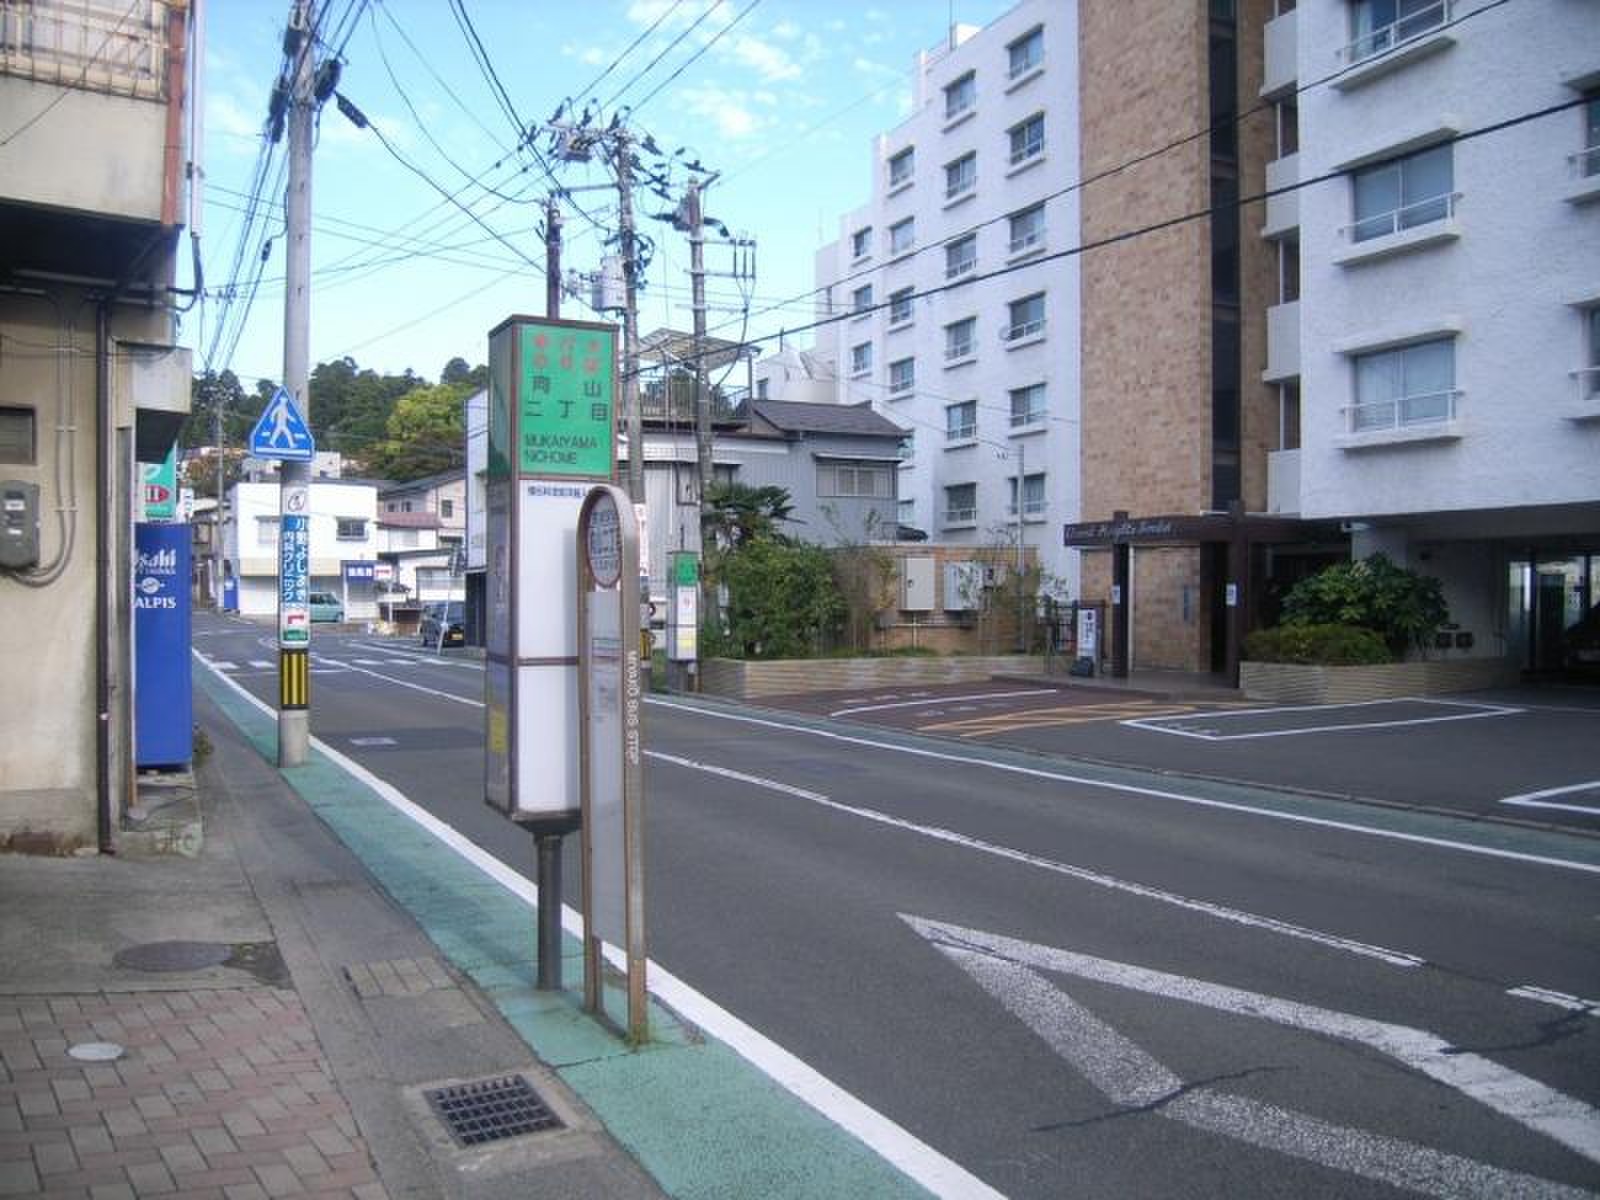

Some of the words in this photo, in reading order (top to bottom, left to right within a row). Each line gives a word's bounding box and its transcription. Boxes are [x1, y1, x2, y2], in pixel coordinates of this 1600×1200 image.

[524, 400, 608, 422] 二丁目
[525, 433, 598, 449] MUKAIYAMA
[136, 596, 177, 608] ALPIS
[628, 729, 639, 765] STOP
